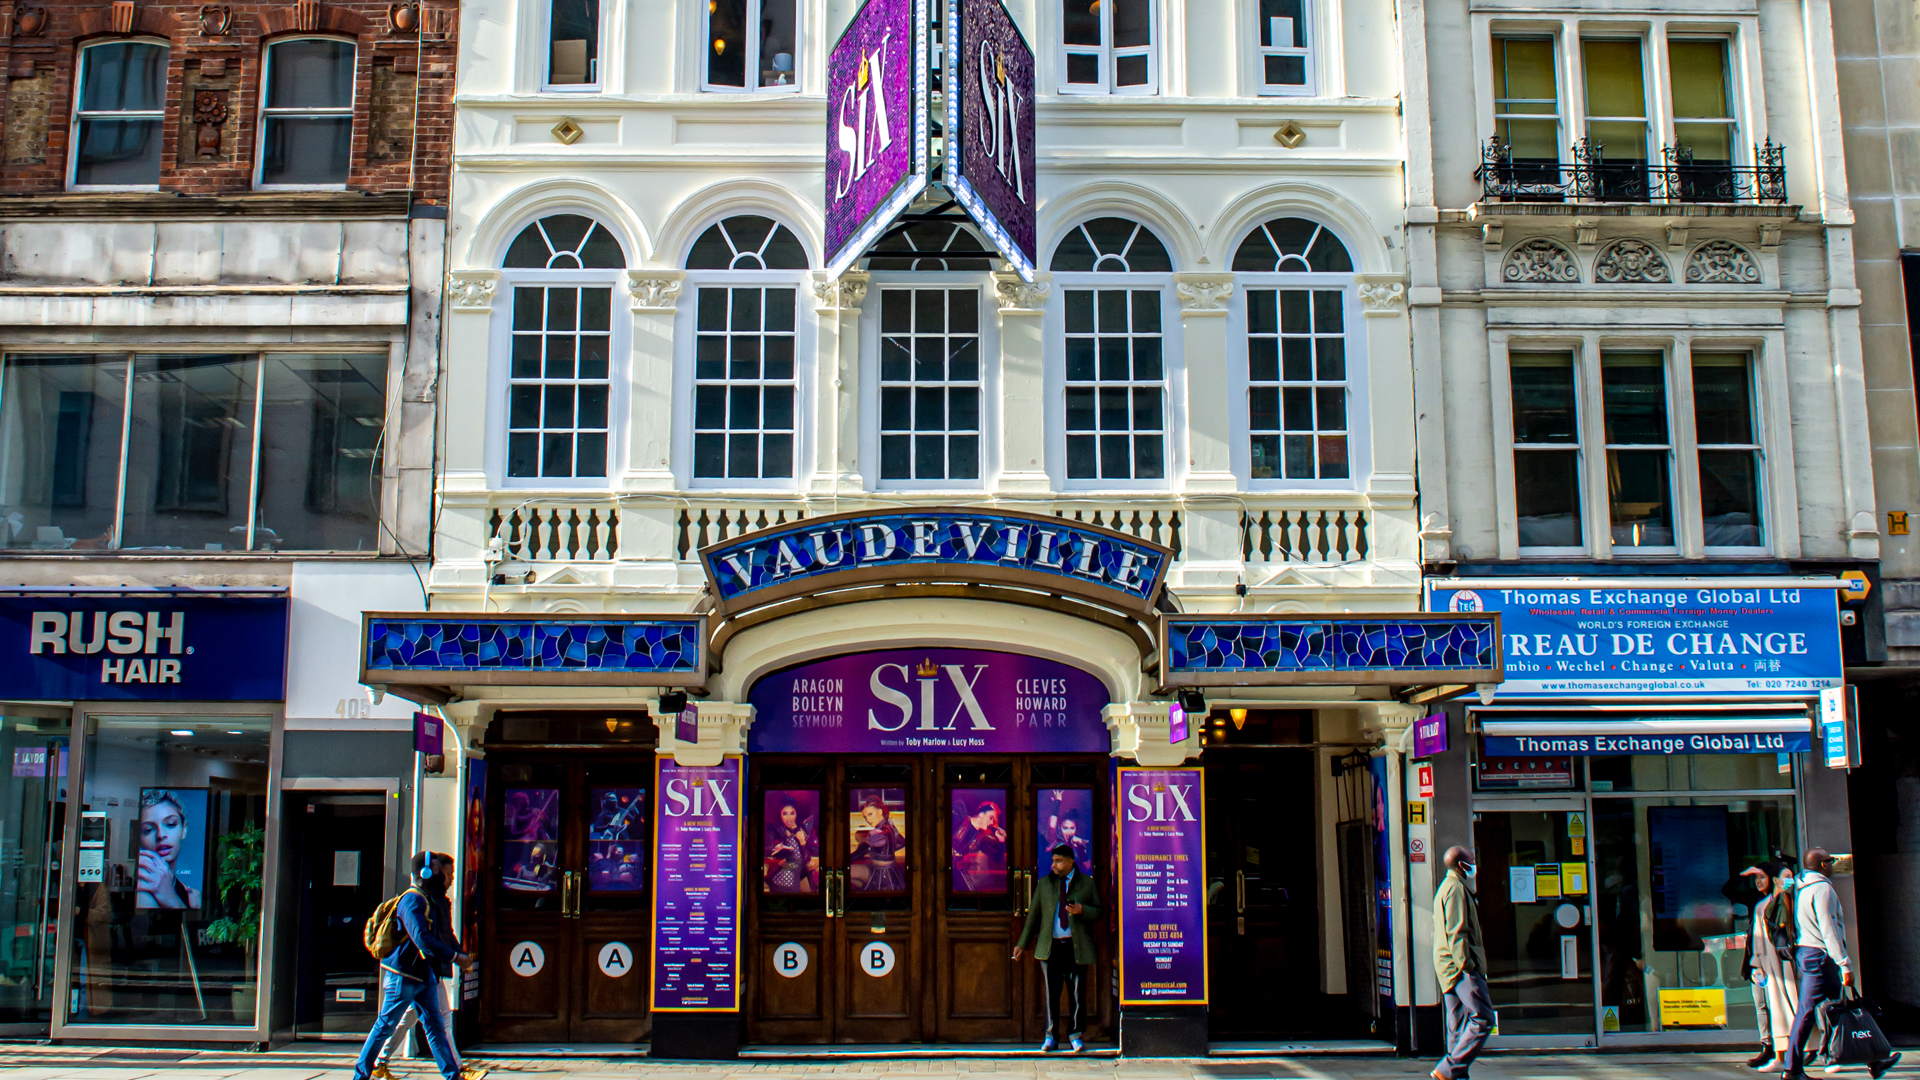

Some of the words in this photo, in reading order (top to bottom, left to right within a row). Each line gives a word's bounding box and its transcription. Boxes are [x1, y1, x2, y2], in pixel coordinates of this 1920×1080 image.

[722, 521, 1149, 590] VAUDEVILLE
[1501, 590, 1581, 605] Thomas
[1590, 589, 1687, 607] Exchange
[1696, 588, 1760, 604] Global
[1769, 588, 1801, 604] Ltd
[1458, 601, 1475, 612] TEG
[1673, 608, 1706, 616] Foreign
[1709, 608, 1738, 616] Money
[1741, 607, 1774, 615] Dealers
[1577, 621, 1624, 629] WORLD'S
[1627, 620, 1672, 629] FOREIGN
[1675, 620, 1730, 629] EXCHANGE
[30, 611, 184, 655] RUSH
[1502, 633, 1598, 656] REAU
[1611, 633, 1655, 656] DE
[1667, 632, 1808, 656] CHANGE
[101, 658, 182, 684] HAIR
[1505, 660, 1541, 672] mbio
[1556, 660, 1606, 672] Wechel
[1620, 660, 1674, 674] Change
[1689, 660, 1734, 671] Valuta
[1754, 658, 1781, 673] 両替
[793, 678, 843, 694] ARAGON
[1016, 678, 1067, 695] CLEVES
[1541, 680, 1705, 691] www.thomasexchangeglobal.co.uk
[1746, 679, 1761, 689] Tel:
[1765, 679, 1782, 688] 020
[1785, 679, 1807, 688] 7240
[1810, 679, 1831, 688] 1214
[335, 698, 371, 719] 405
[793, 696, 843, 712] BOLEYN
[1016, 696, 1067, 711] HOWARD
[793, 714, 843, 729] SEYMOUR
[1016, 713, 1067, 728] PARR
[906, 737, 921, 748] Toby
[922, 737, 946, 746] Marlow
[952, 737, 967, 747] Lucy
[968, 737, 985, 746] Moss
[1515, 736, 1589, 751] Thomas
[1595, 735, 1685, 753] Exchange
[1689, 734, 1750, 749] Global
[1755, 733, 1784, 748] Ltd
[1409, 803, 1425, 823] H
[517, 947, 537, 968] A
[605, 948, 625, 969] A
[783, 949, 799, 970] B
[870, 949, 886, 969] B
[1851, 1030, 1872, 1039] next
